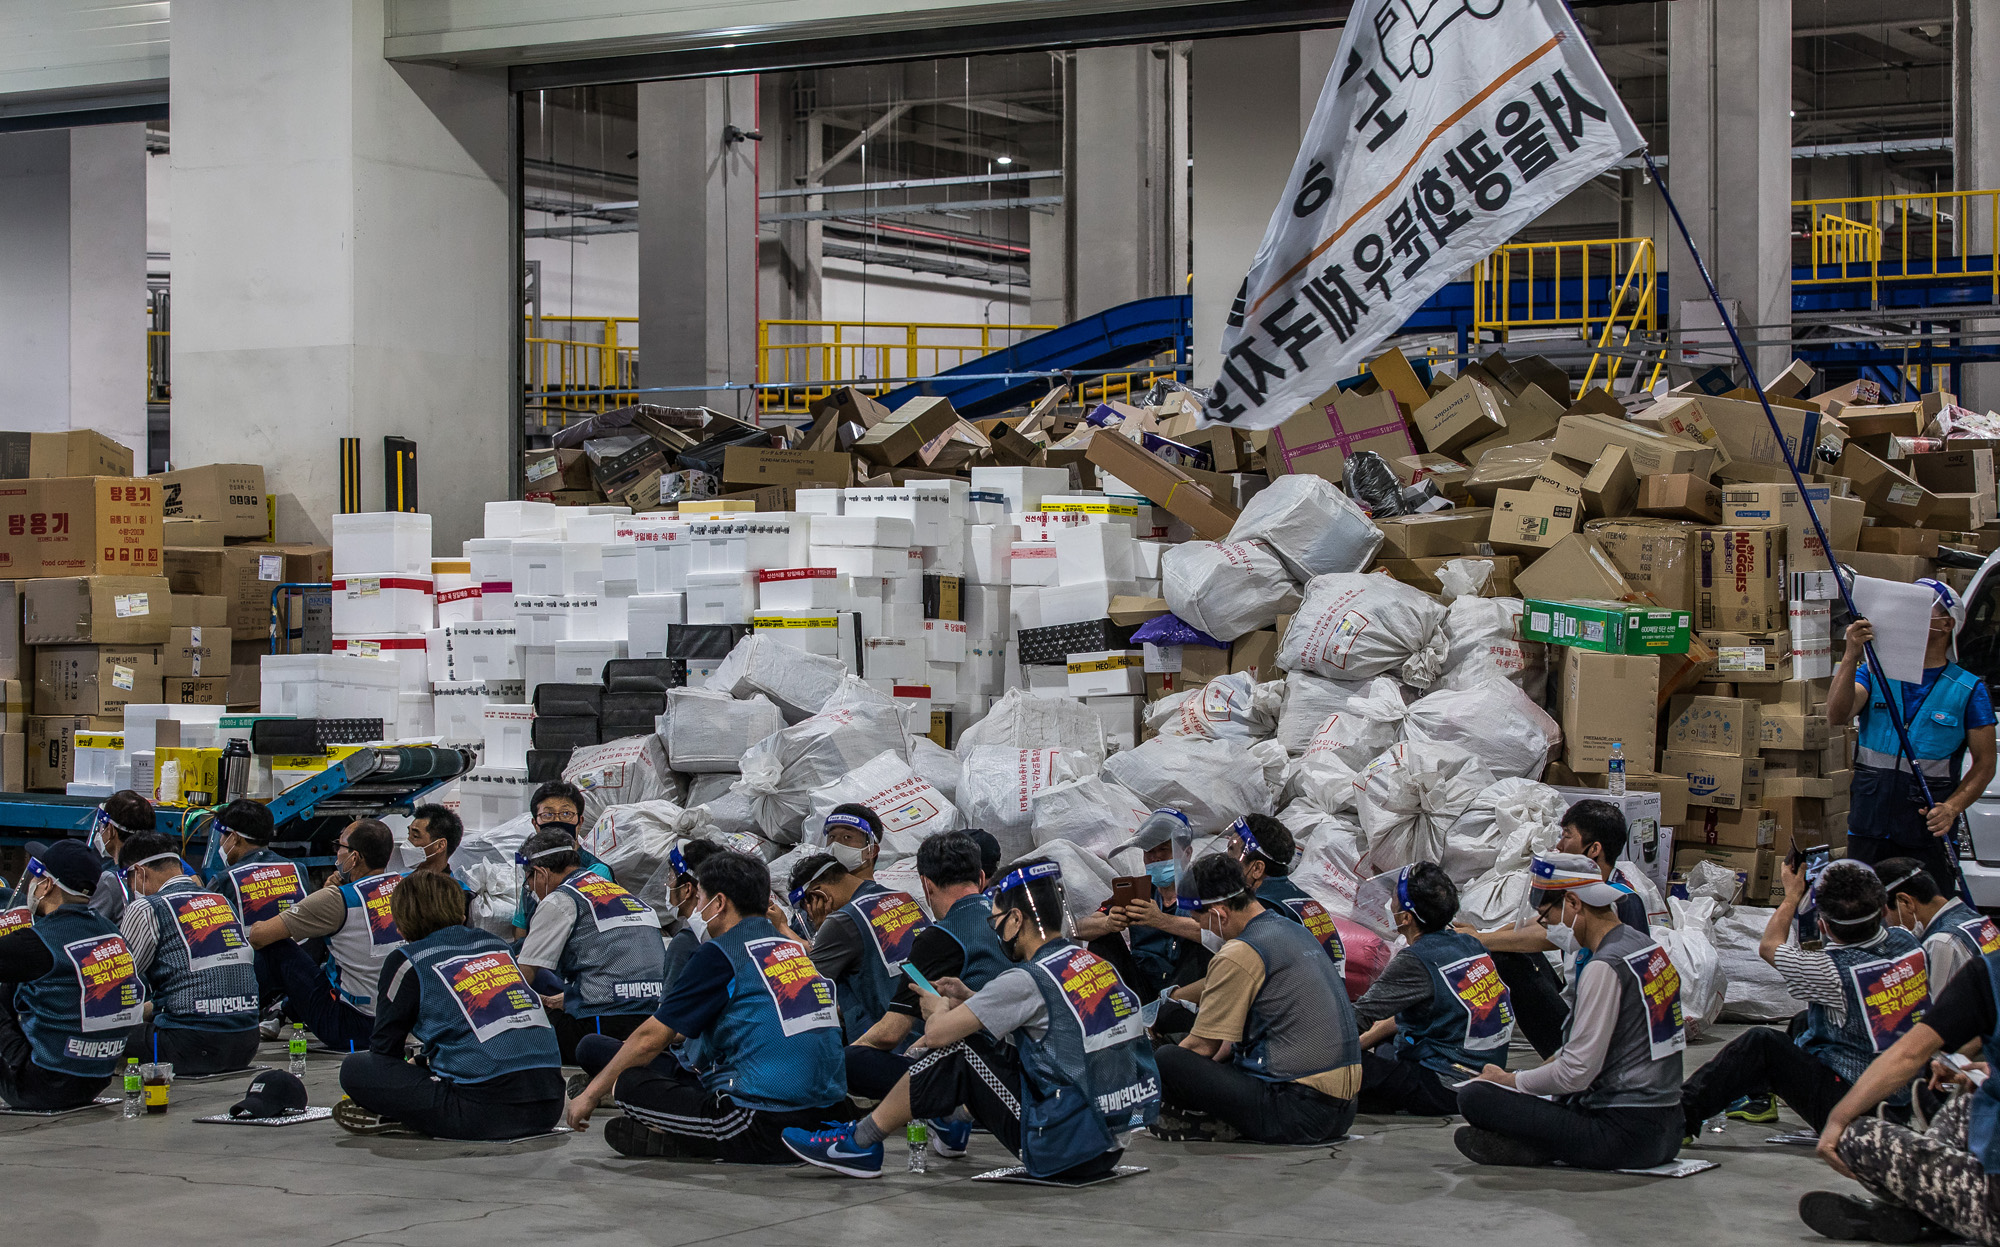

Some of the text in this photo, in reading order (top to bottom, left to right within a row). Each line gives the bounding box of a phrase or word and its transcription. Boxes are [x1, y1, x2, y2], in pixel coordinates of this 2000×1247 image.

[1434, 397, 1463, 420] Electrolux
[110, 486, 151, 502] 탕용기
[166, 506, 183, 515] ZAPS
[8, 512, 69, 536] 탕용기
[1641, 544, 1653, 552] PCS
[57, 559, 86, 568] container
[1735, 532, 1750, 592] HUGGIES
[1747, 544, 1755, 573] 하기스
[1640, 563, 1652, 572] KGS
[182, 683, 212, 692] 92 PET
[182, 693, 213, 703] 16 CUP
[1643, 798, 1659, 806] CUCKOO
[253, 869, 282, 882] 분류작업
[1032, 866, 1045, 874] Face
[240, 874, 299, 893] 택배사가 책임지고
[250, 890, 267, 901] 즉각
[189, 897, 217, 910] 분류작업
[178, 909, 209, 923] 택배사가
[870, 908, 900, 928] 택배사가
[190, 918, 209, 930] 즉각
[883, 920, 901, 934] 즉각
[93, 940, 123, 961] 분류작업
[82, 959, 114, 977] 택배사가
[464, 957, 500, 975] 분류작업
[764, 960, 798, 978] 택배사가
[93, 970, 110, 986] 즉각
[453, 964, 519, 992] 택배사가 책임지고
[778, 971, 798, 985] 즉각
[1063, 969, 1095, 993] 택배사가
[1881, 961, 1915, 988] 분류작업
[468, 981, 490, 996] 즉각
[1077, 985, 1097, 999] 즉각
[1458, 982, 1486, 1000] 택배사가
[1865, 969, 1928, 1006] 택배사가 책임지고
[195, 995, 259, 1015] 택배연대노조
[1471, 995, 1489, 1007] 즉각
[1879, 1001, 1901, 1016] 즉각
